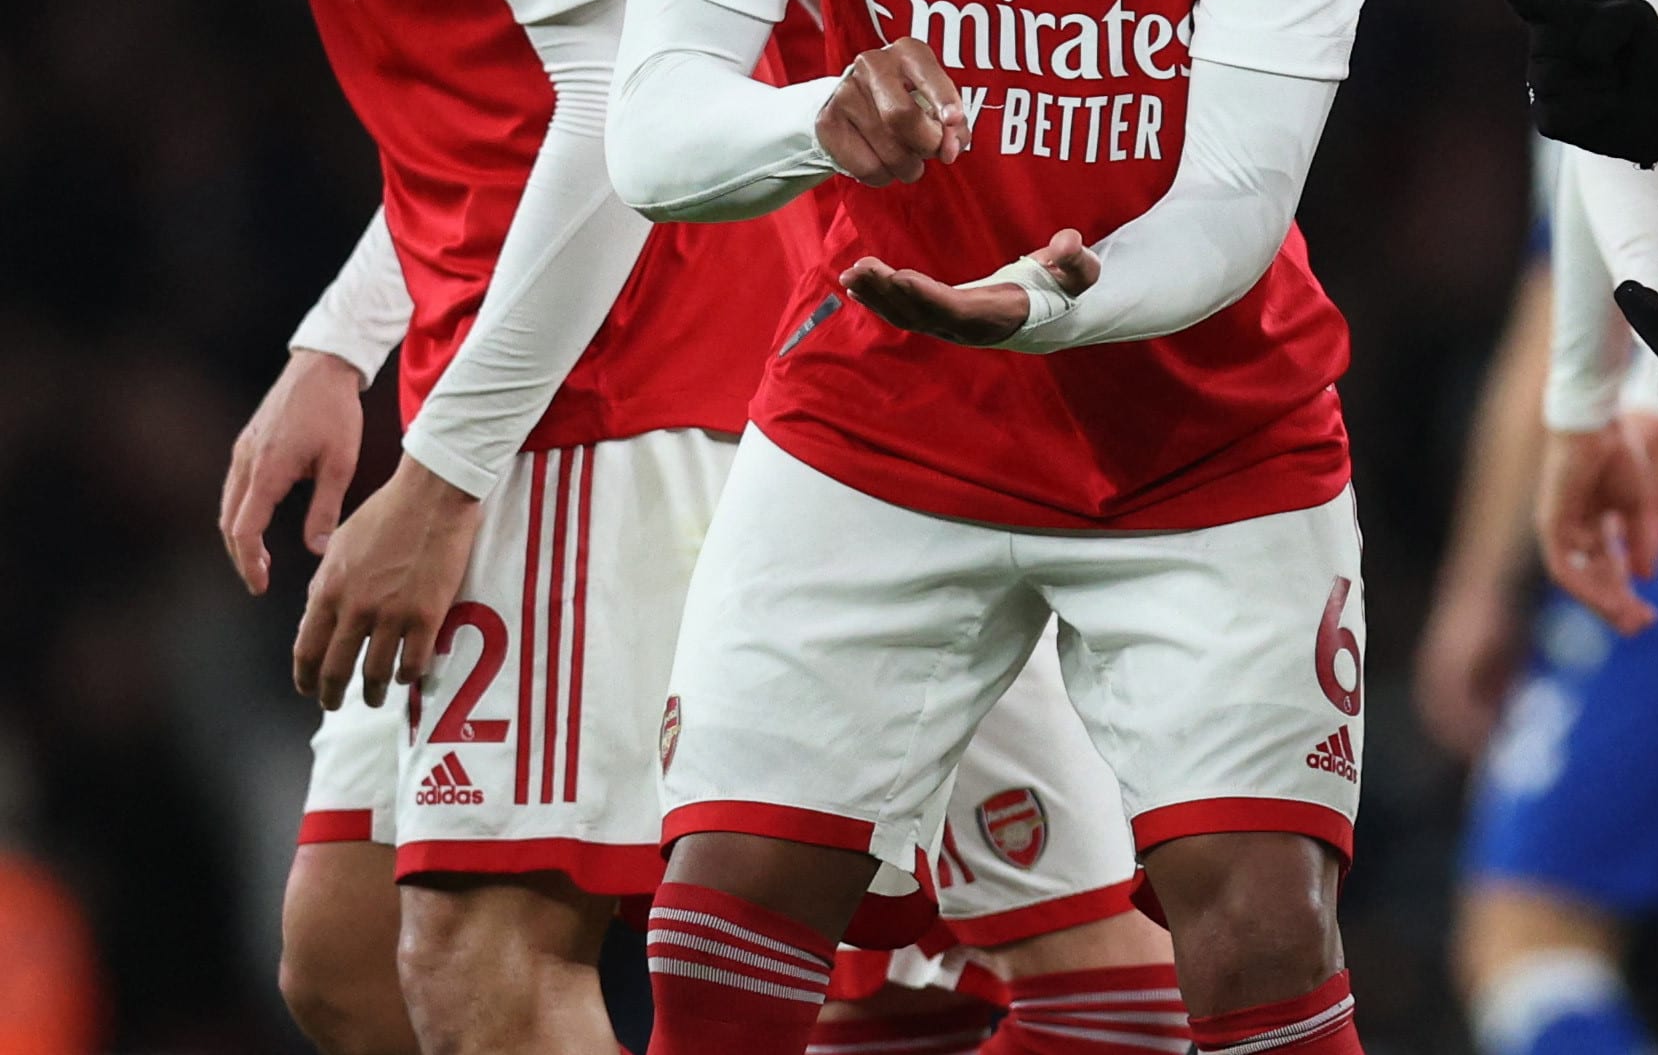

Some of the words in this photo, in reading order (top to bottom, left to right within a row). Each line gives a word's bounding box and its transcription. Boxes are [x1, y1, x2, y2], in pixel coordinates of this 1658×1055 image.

[1000, 87, 1163, 163] BETTER
[1315, 575, 1361, 717] 6
[416, 785, 484, 805] adidas
